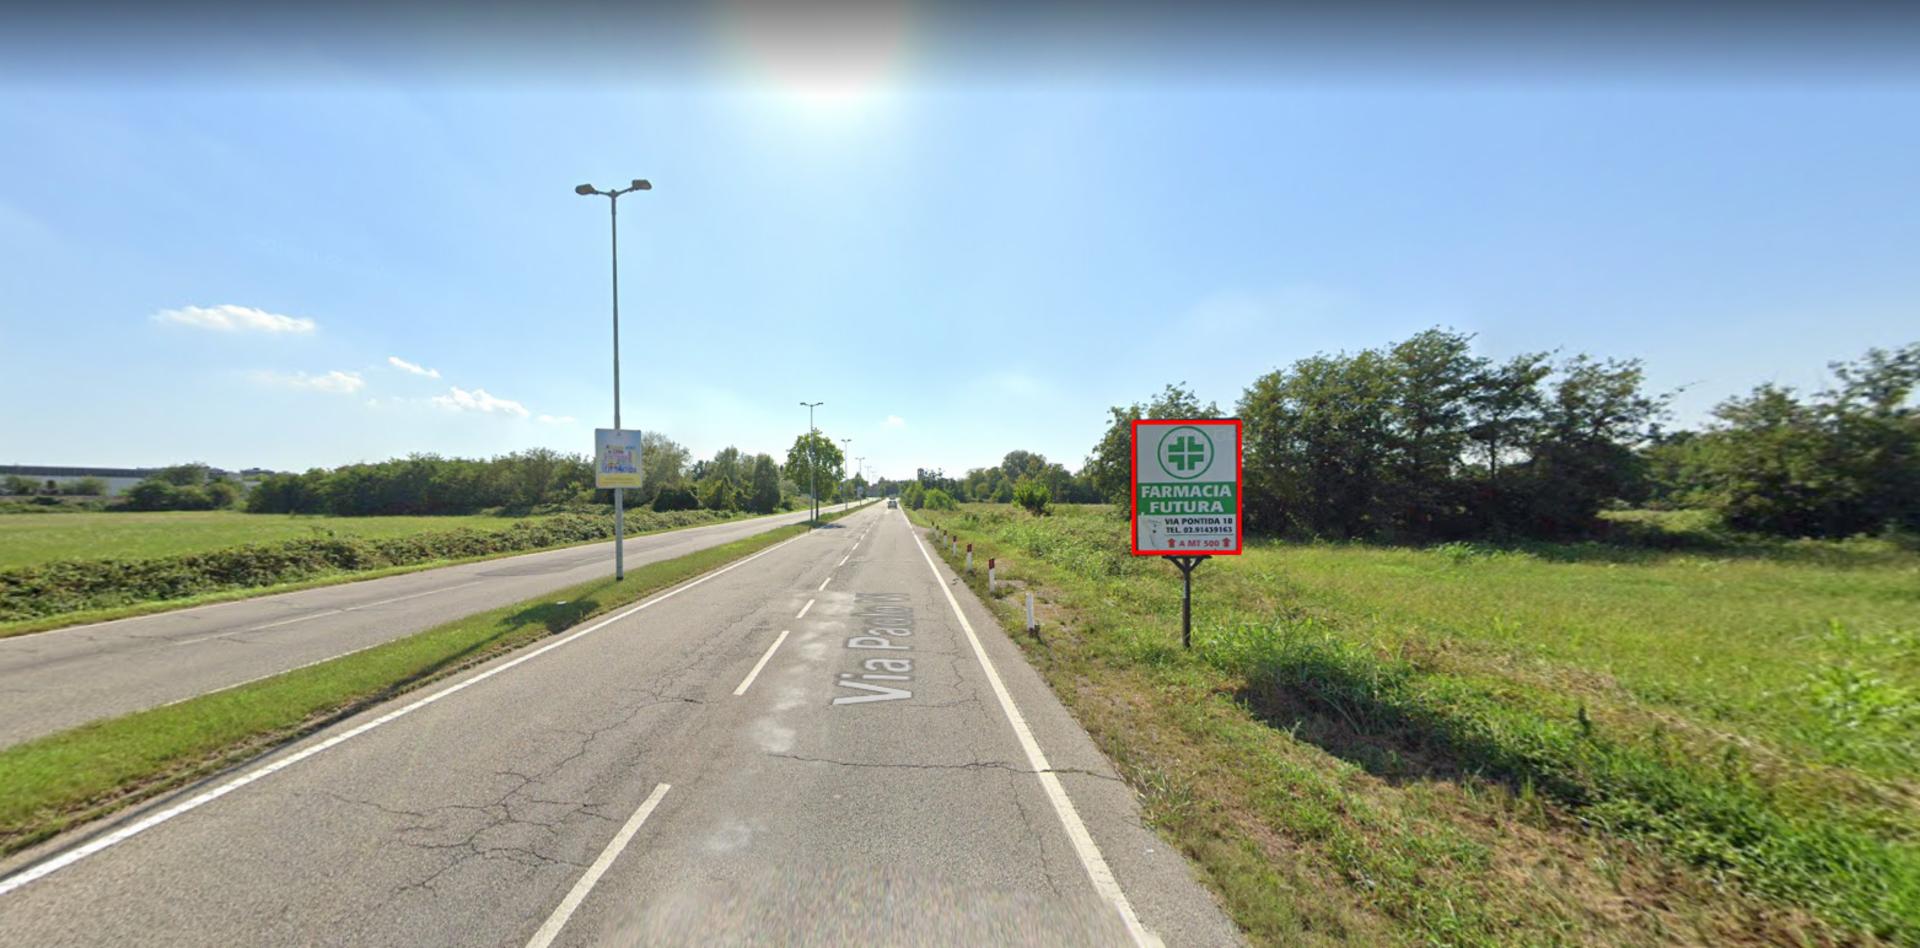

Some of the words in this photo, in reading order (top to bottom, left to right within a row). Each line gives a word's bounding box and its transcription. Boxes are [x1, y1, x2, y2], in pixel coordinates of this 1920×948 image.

[1141, 485, 1232, 498] FARMACIA
[1149, 501, 1224, 513] FUTURA
[1165, 518, 1179, 526] VIA
[1204, 539, 1220, 547] 500
